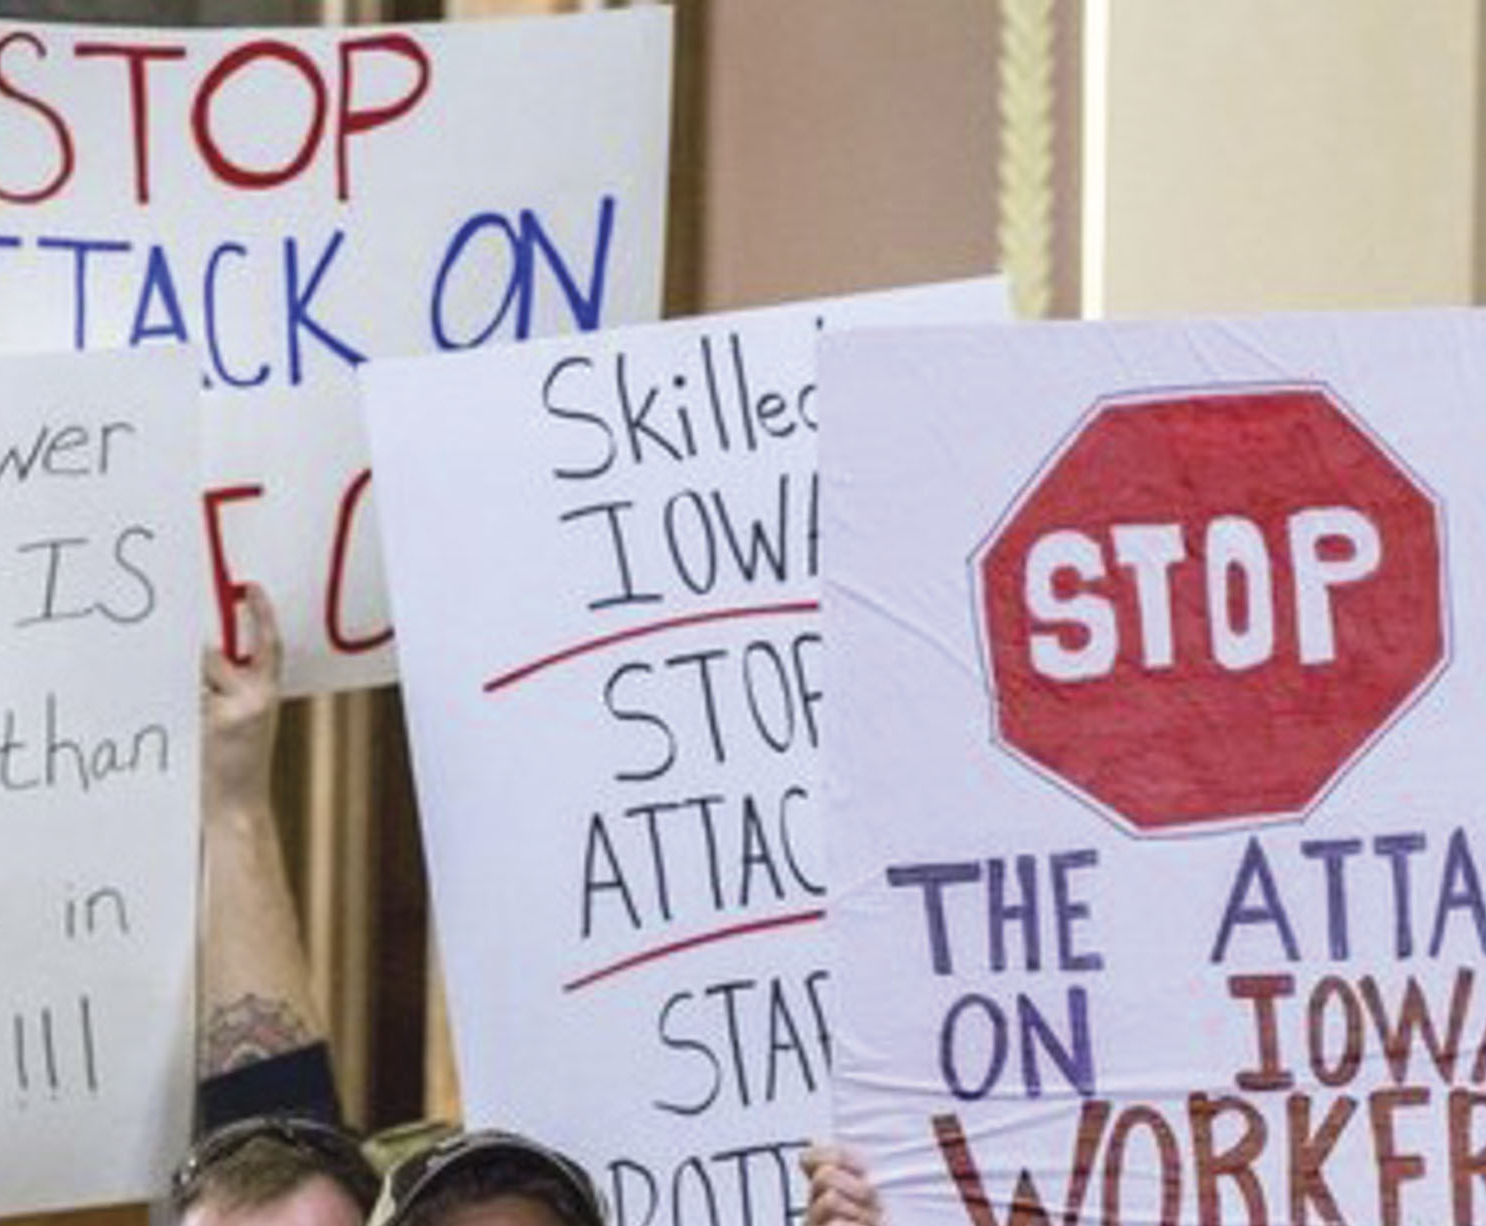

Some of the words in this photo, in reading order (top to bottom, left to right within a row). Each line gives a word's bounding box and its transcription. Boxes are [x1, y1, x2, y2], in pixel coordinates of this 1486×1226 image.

[429, 196, 618, 352] ON
[16, 525, 158, 628] IS
[1023, 504, 1382, 683] STOP
[65, 884, 130, 939] in
[580, 785, 827, 940] ATTAC
[885, 849, 1105, 976] THE
[938, 986, 1099, 1102] ON
